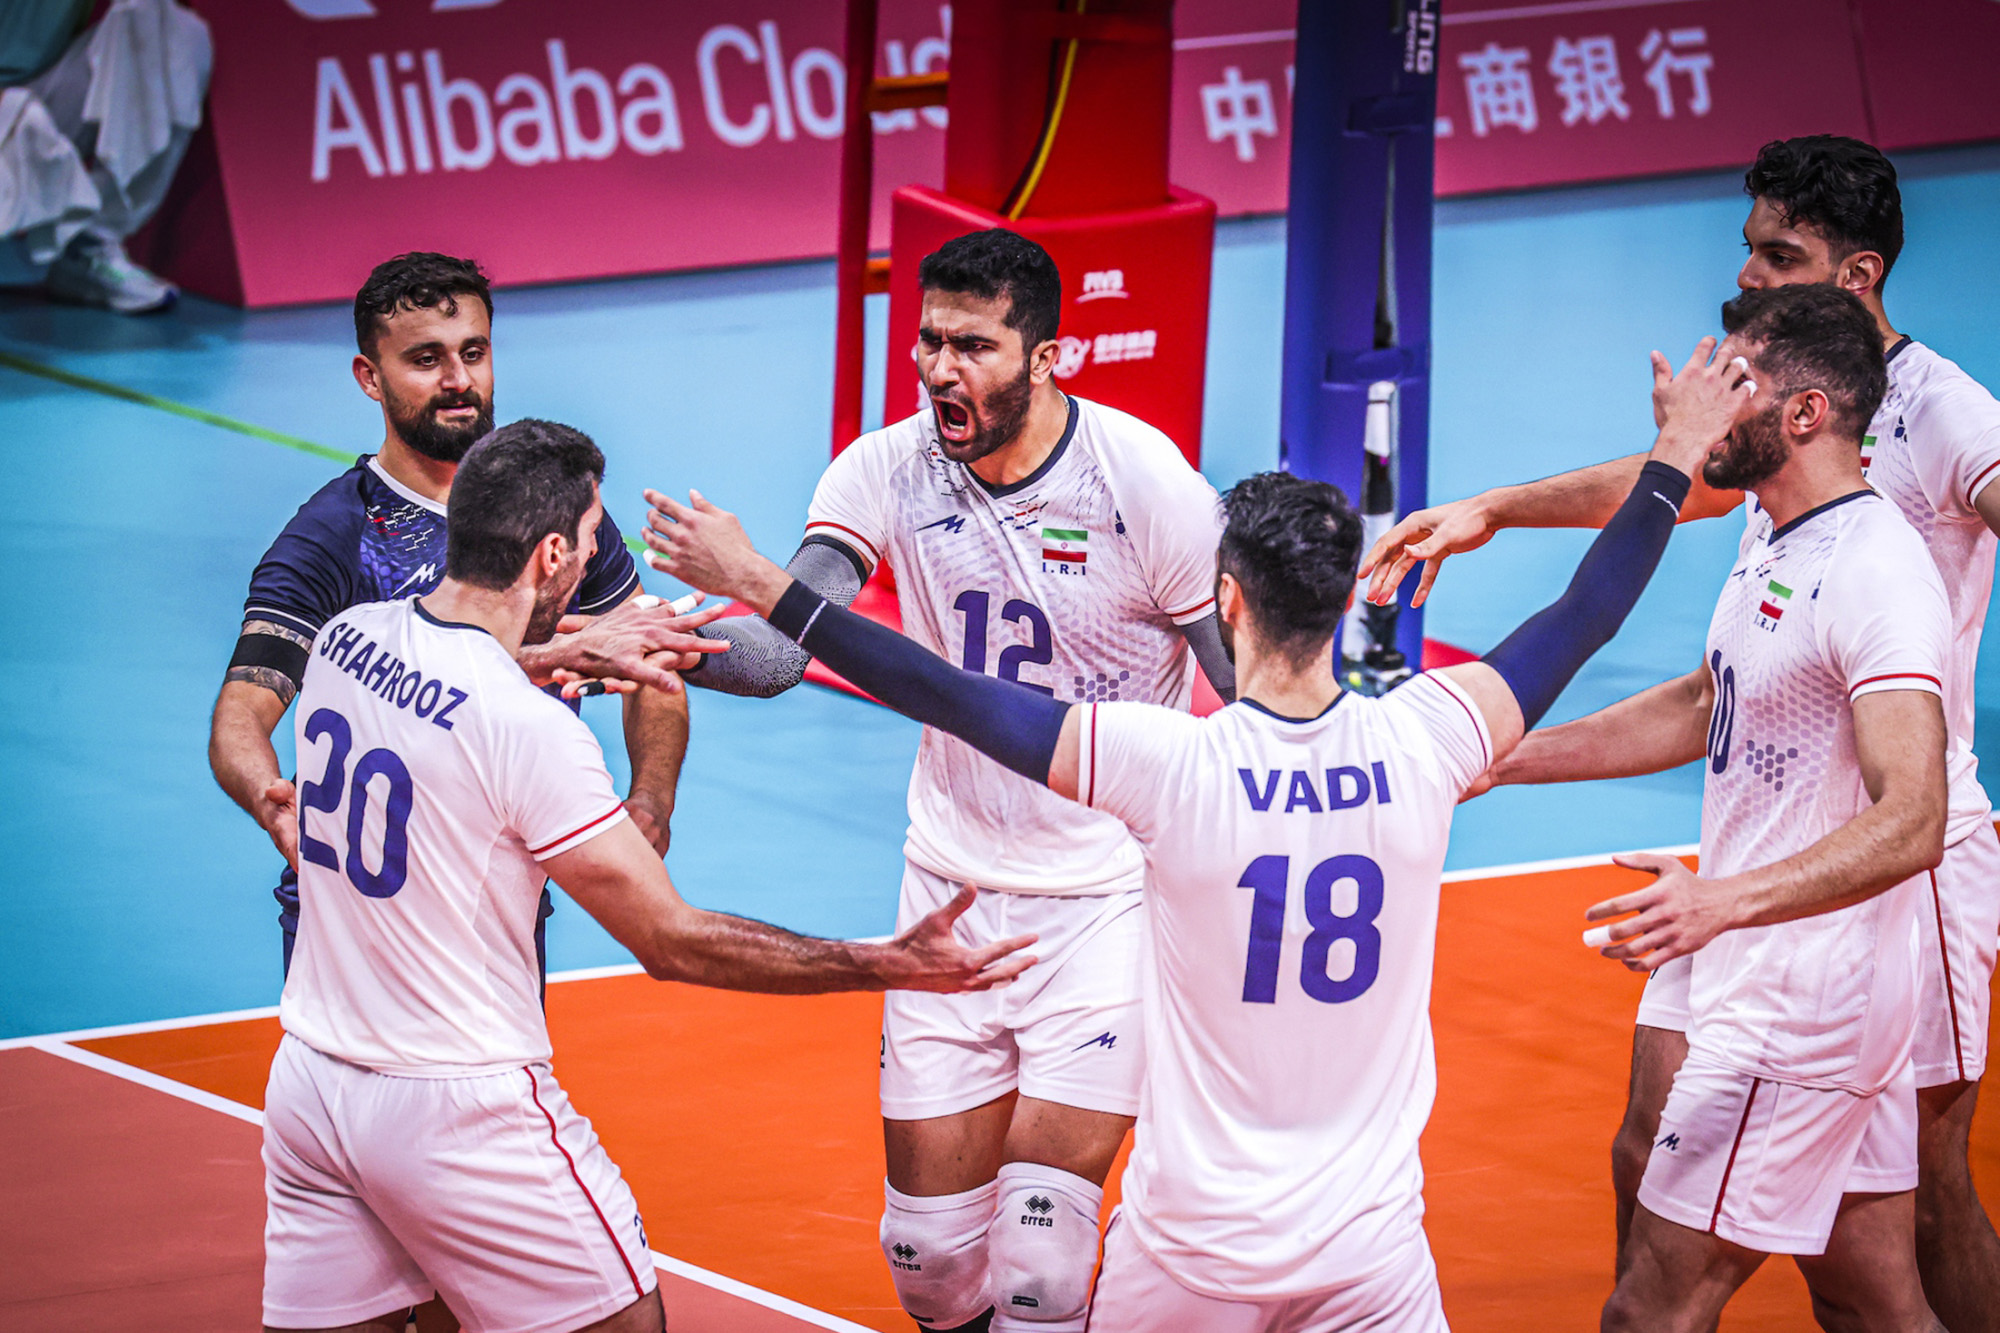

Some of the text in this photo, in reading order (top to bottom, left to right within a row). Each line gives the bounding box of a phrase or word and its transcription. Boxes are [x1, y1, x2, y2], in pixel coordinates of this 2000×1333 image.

[311, 38, 684, 183] Alibaba
[1200, 28, 1714, 163] 中商銀行
[320, 622, 469, 732] SHAHROOZ
[953, 590, 1053, 699] 12
[1707, 649, 1735, 775] 10
[299, 708, 413, 899] 20
[1237, 761, 1391, 813] VADI
[1237, 854, 1384, 1004] 18
[893, 1261, 921, 1271] errea
[1021, 1214, 1053, 1227] errea
